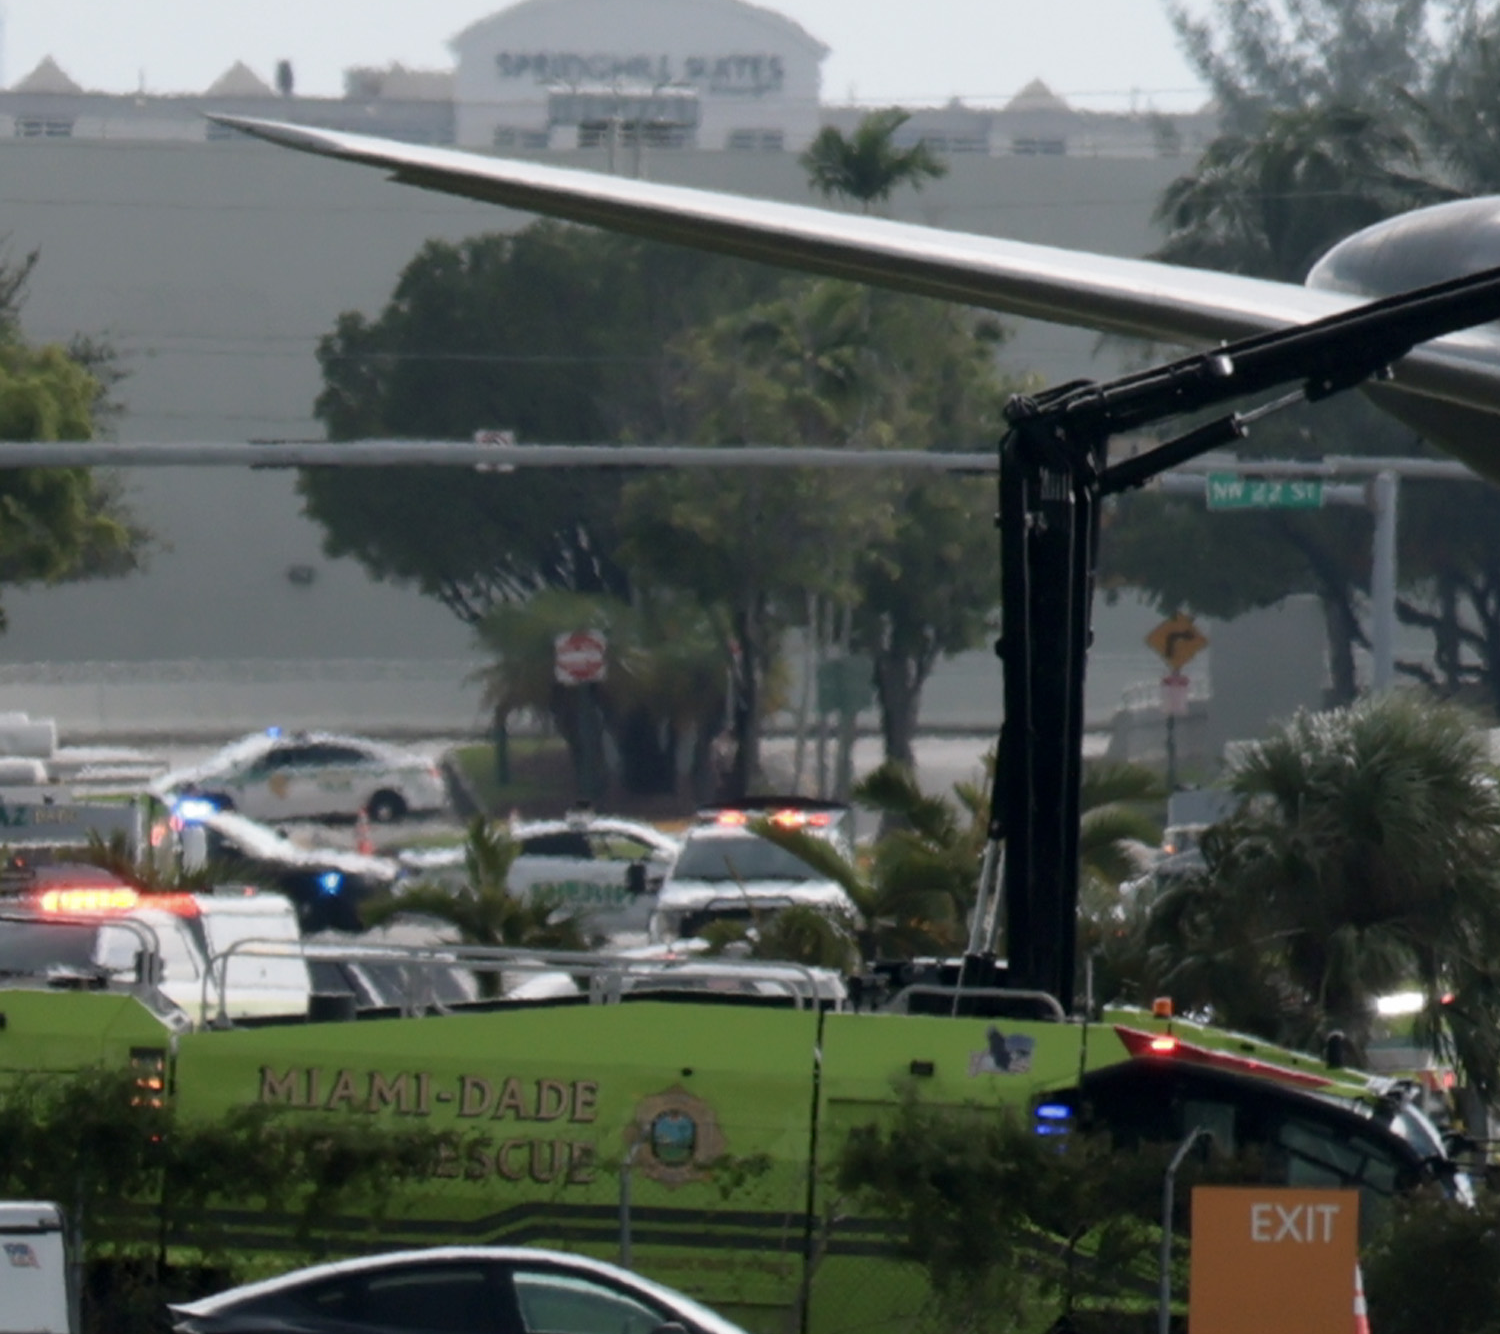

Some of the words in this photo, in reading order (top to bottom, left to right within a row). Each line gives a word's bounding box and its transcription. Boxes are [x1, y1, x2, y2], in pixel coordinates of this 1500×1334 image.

[1212, 480, 1241, 502] NW
[1291, 481, 1316, 502] ST
[260, 1065, 598, 1124] MIAMI-DADE
[410, 1135, 597, 1184] ESCUE
[1251, 1203, 1340, 1244] EXIT
